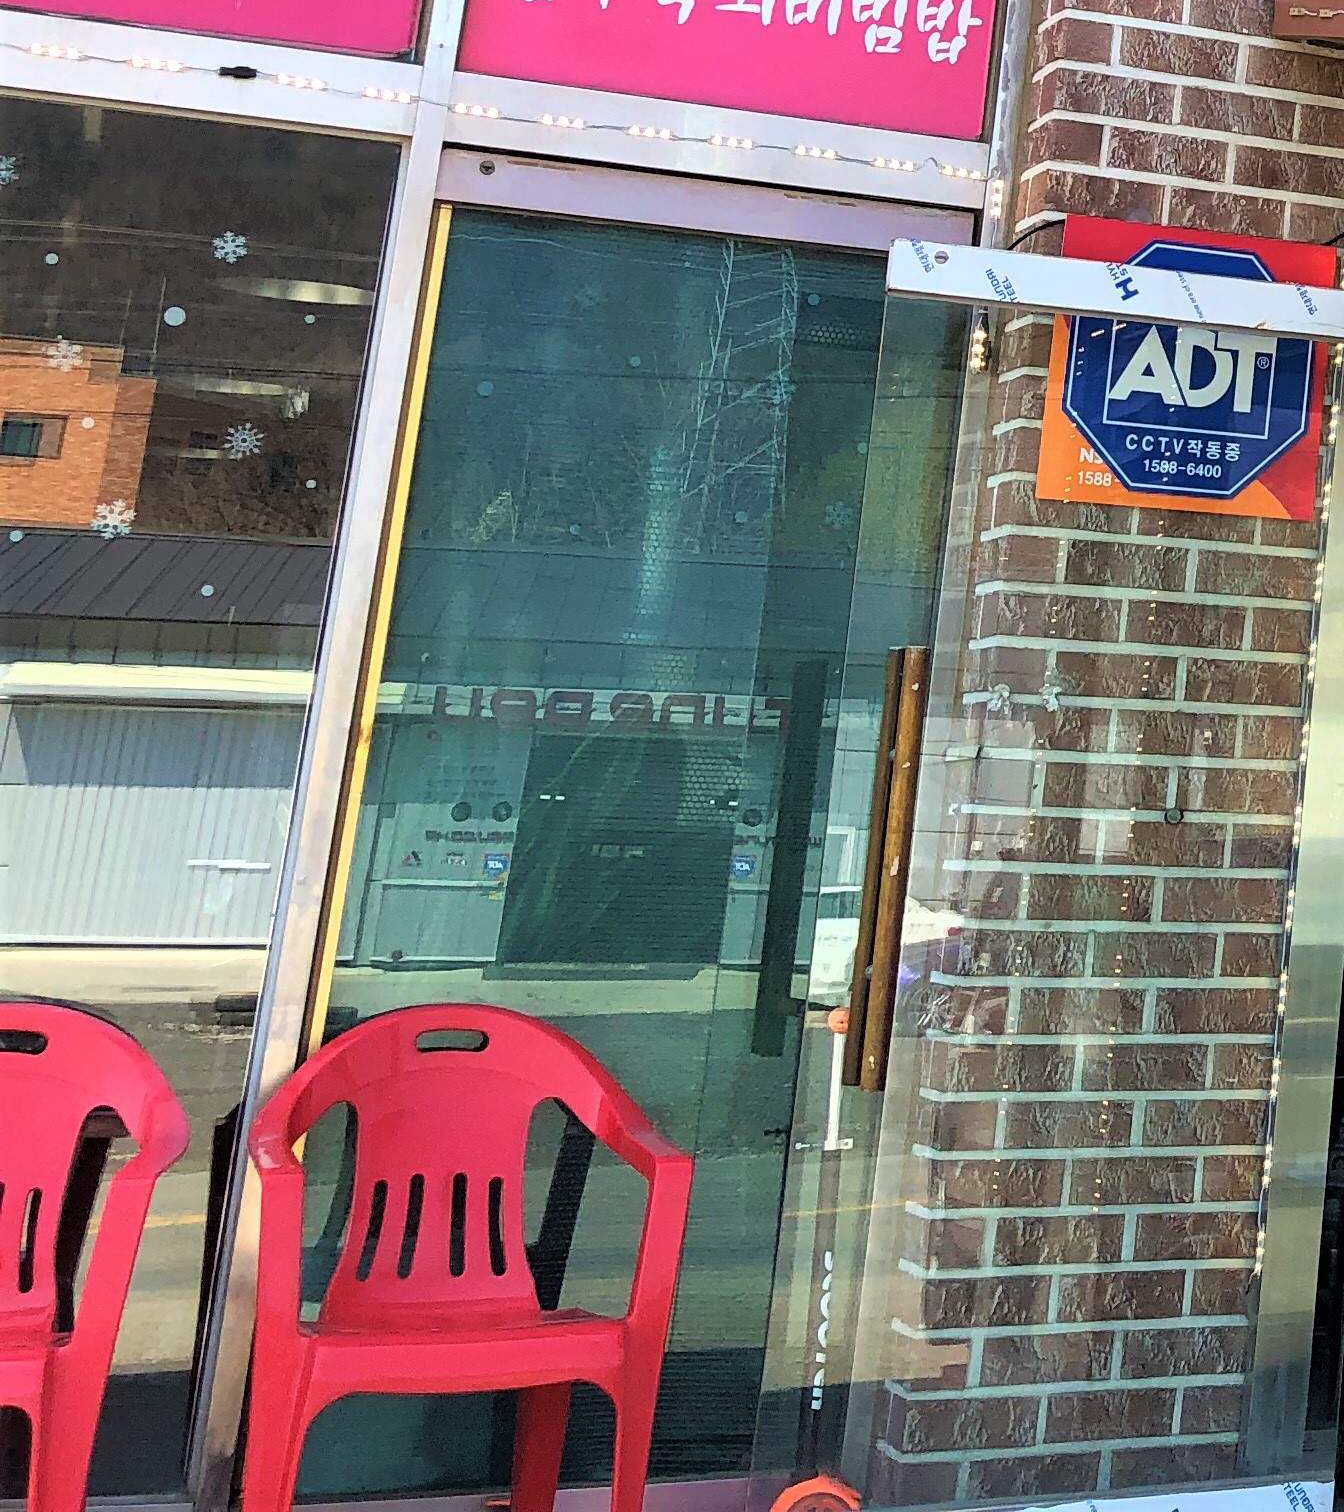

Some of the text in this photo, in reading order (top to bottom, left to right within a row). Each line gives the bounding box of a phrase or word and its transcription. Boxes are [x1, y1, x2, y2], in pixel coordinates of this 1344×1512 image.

[1107, 324, 1278, 414] ADT
[1125, 433, 1242, 463] CCTV작동중
[1143, 458, 1223, 479] 1588-6400
